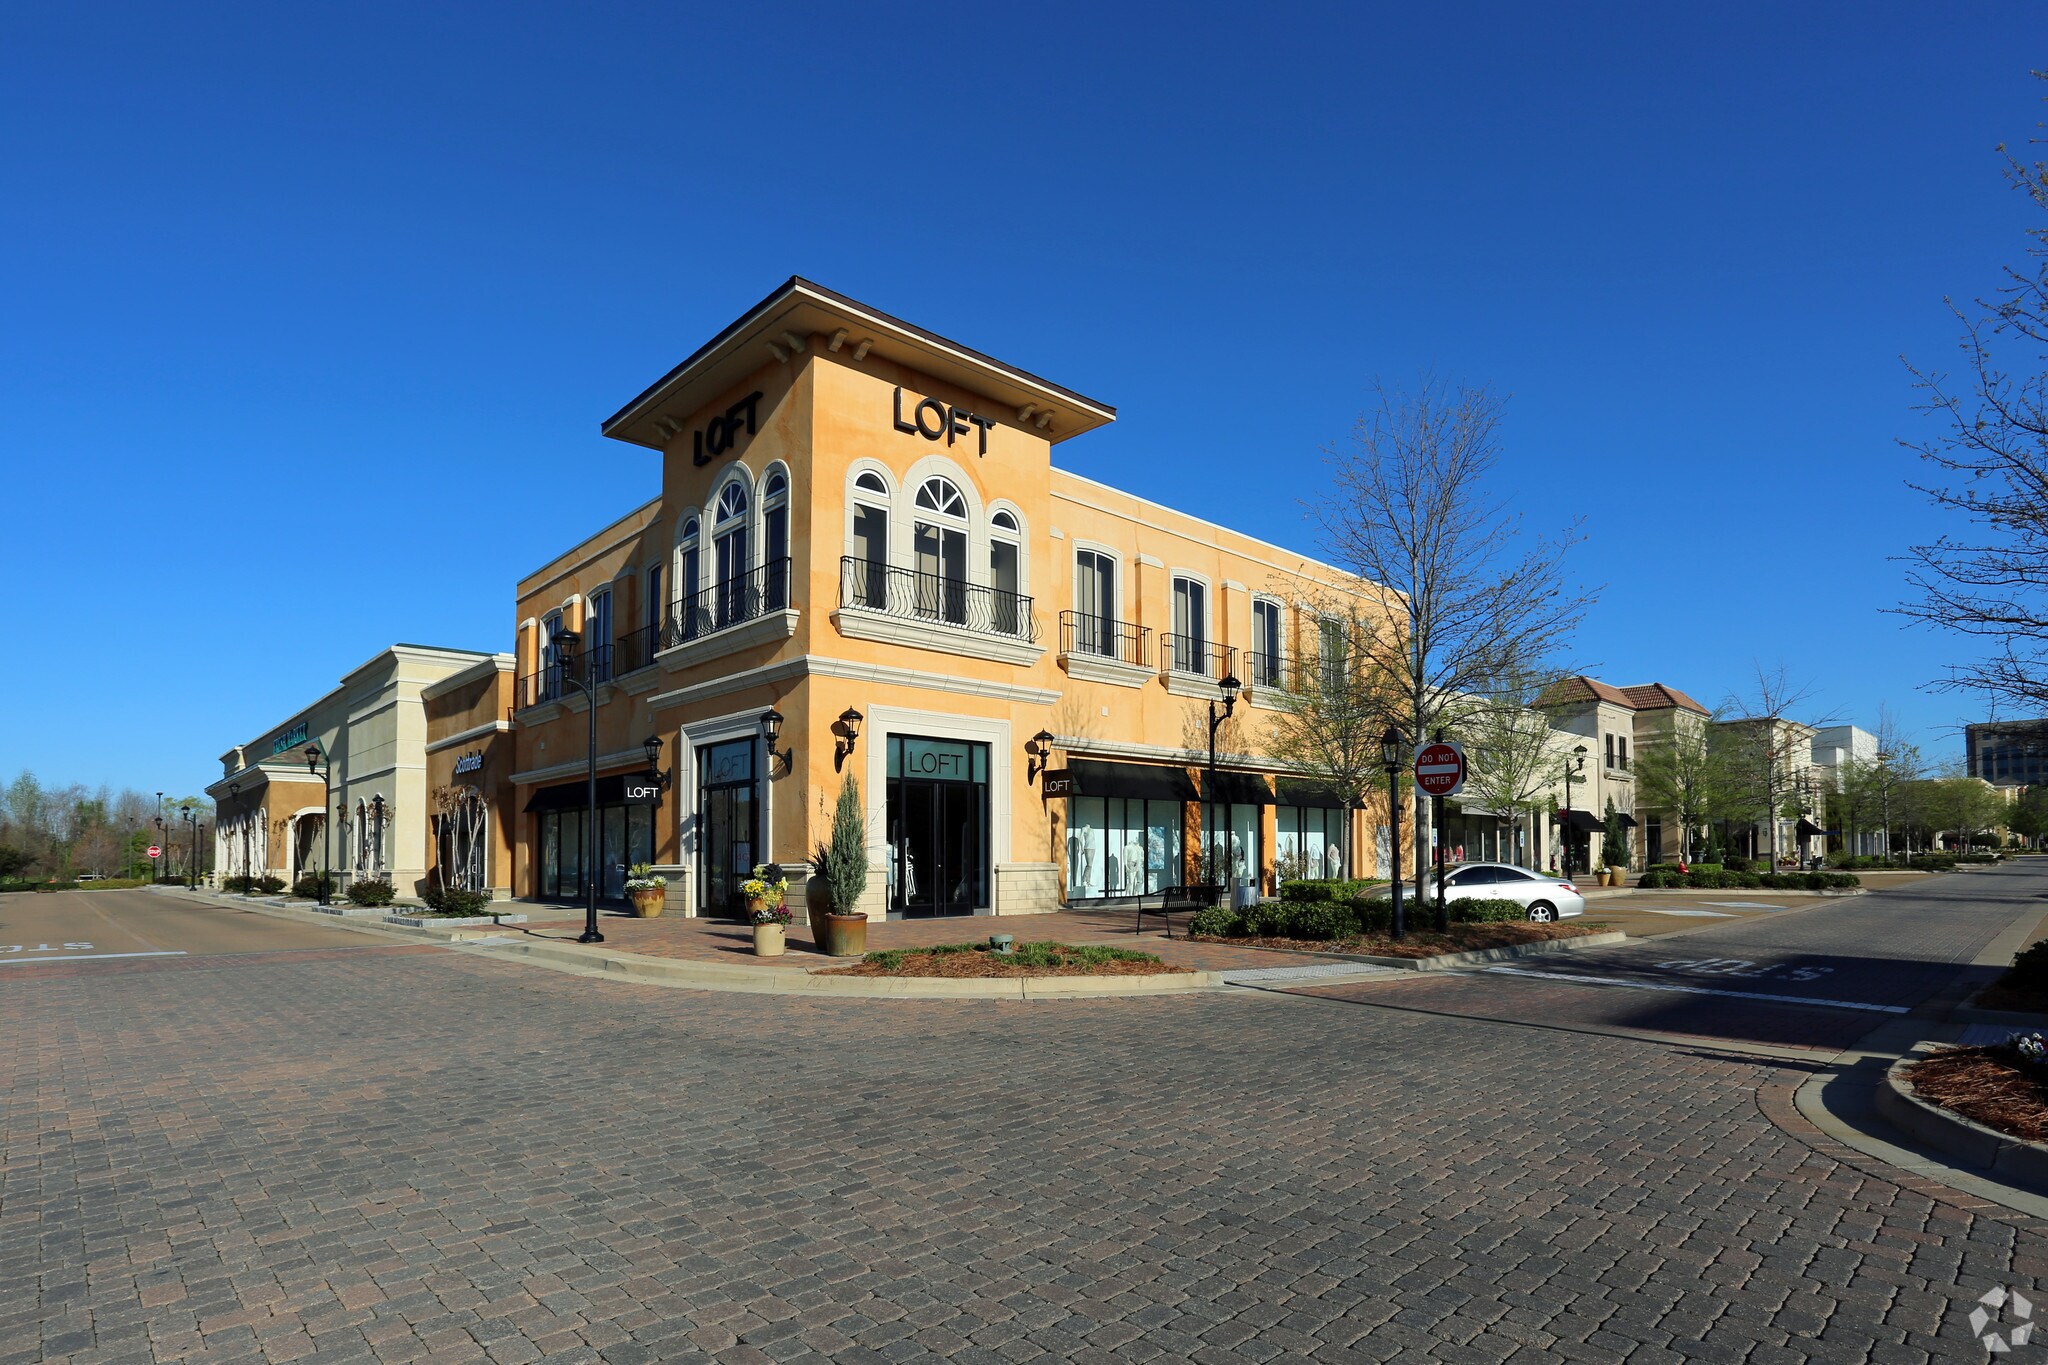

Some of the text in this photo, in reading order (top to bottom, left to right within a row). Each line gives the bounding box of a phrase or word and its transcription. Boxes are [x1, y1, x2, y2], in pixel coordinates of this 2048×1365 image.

[693, 391, 763, 467] LOFT
[893, 386, 997, 458] LOFT
[455, 749, 483, 775] Scottrade
[713, 753, 749, 779] LOFT
[909, 751, 964, 776] LOFT
[1421, 753, 1455, 764] DO NOT
[1044, 779, 1070, 793] LOFT
[1424, 775, 1452, 786] ENTER
[626, 786, 659, 798] LOFT
[0, 942, 95, 953] STO
